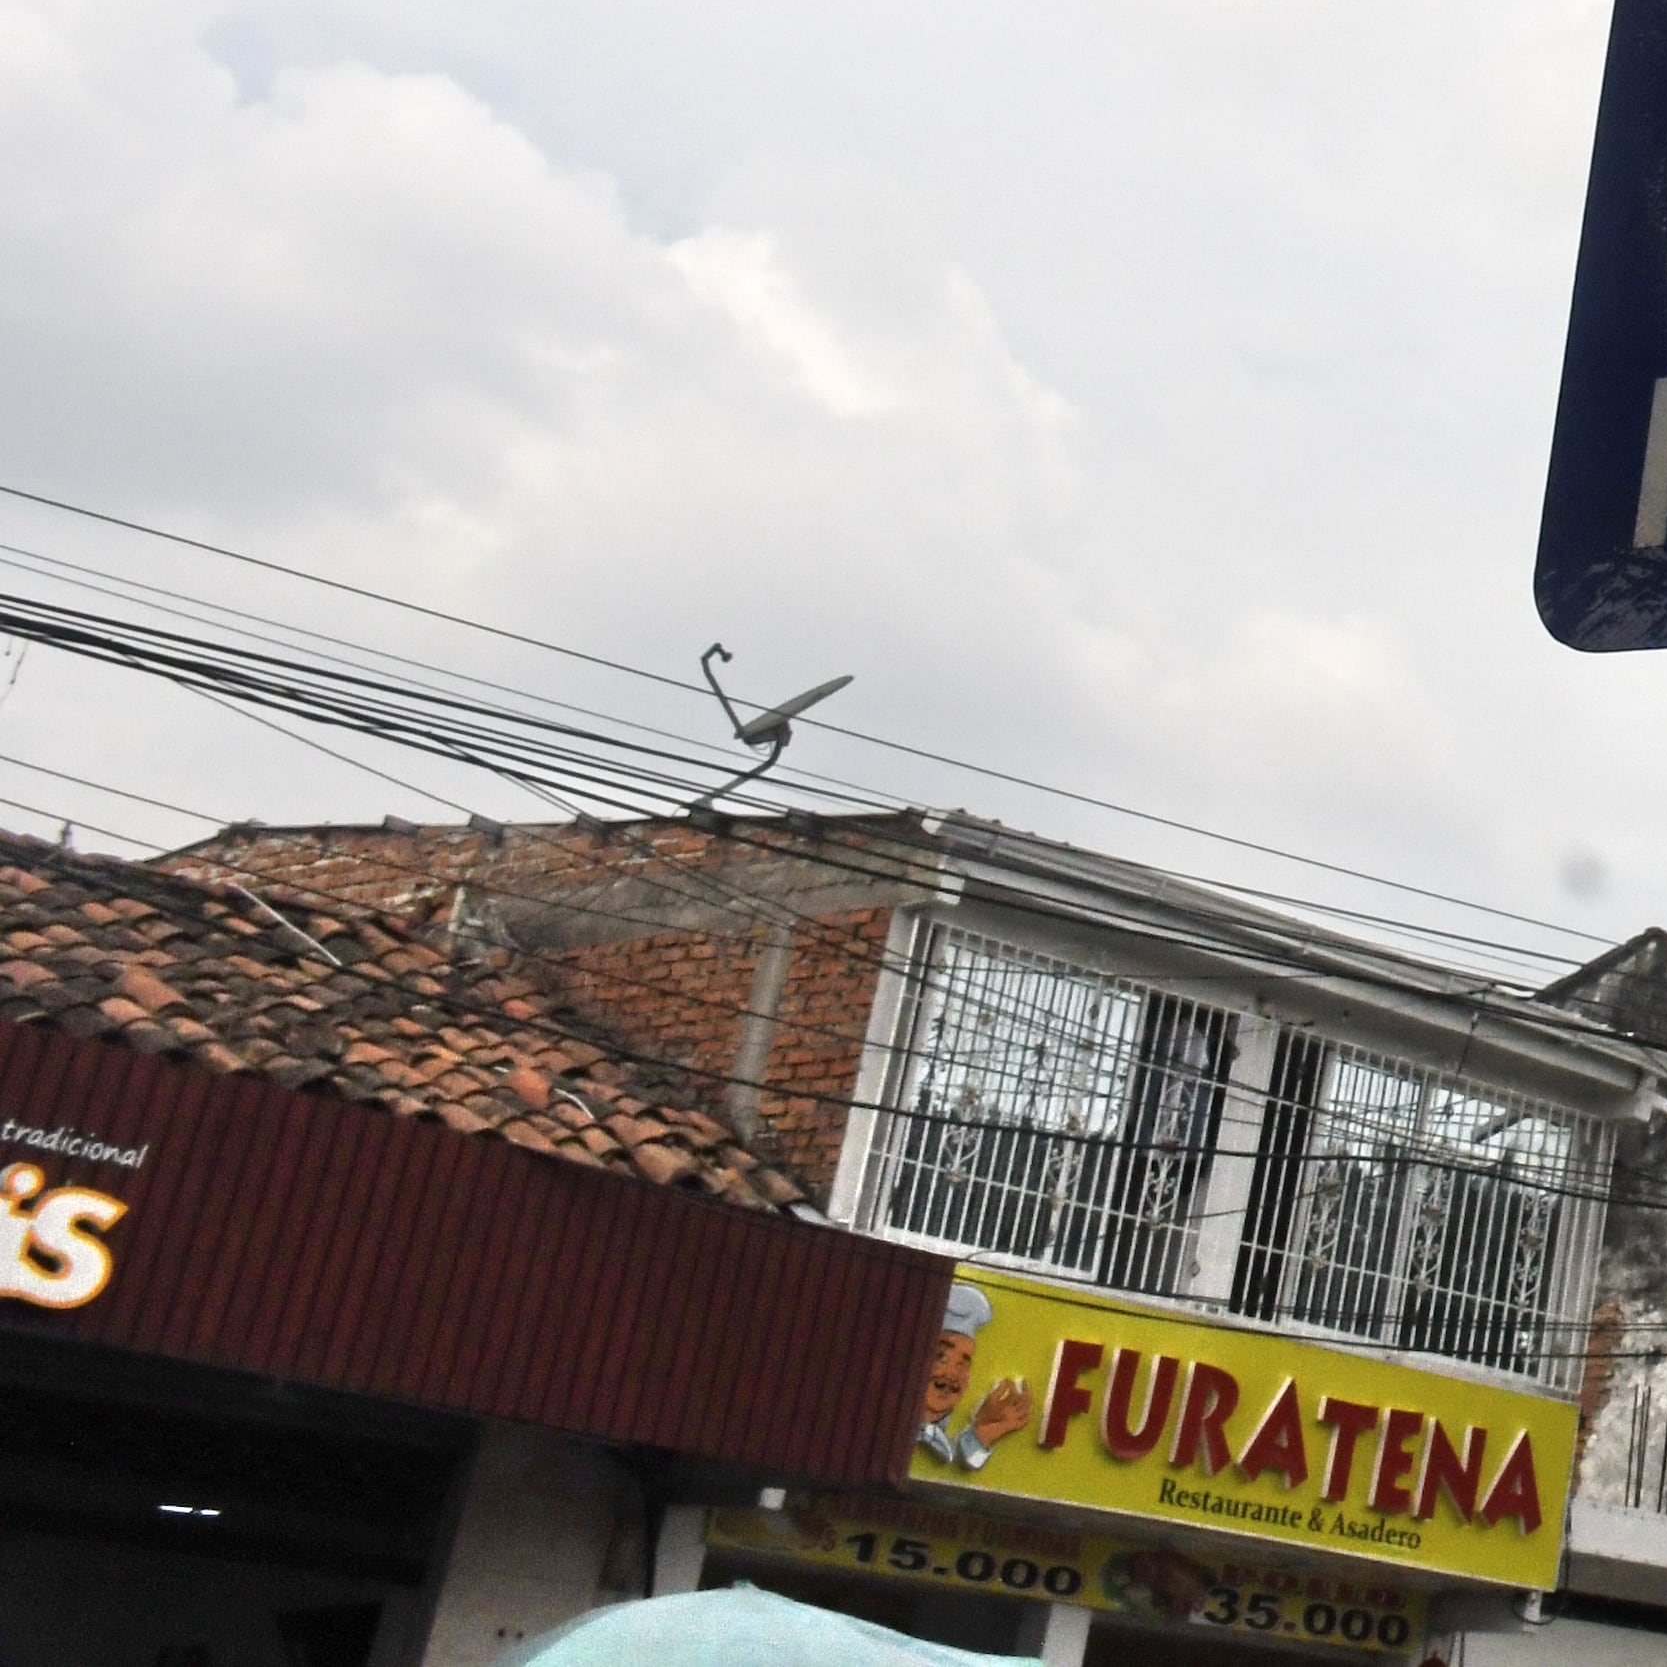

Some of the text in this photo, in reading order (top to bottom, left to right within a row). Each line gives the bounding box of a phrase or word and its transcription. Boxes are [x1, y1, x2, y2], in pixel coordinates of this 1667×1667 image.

[2, 1119, 148, 1169] tradicional
[1037, 1338, 1543, 1536] FURATENA
[1158, 1478, 1422, 1551] Restaurante & Asadero
[844, 1532, 1082, 1596] 15.000
[1204, 1586, 1410, 1647] 35.000
